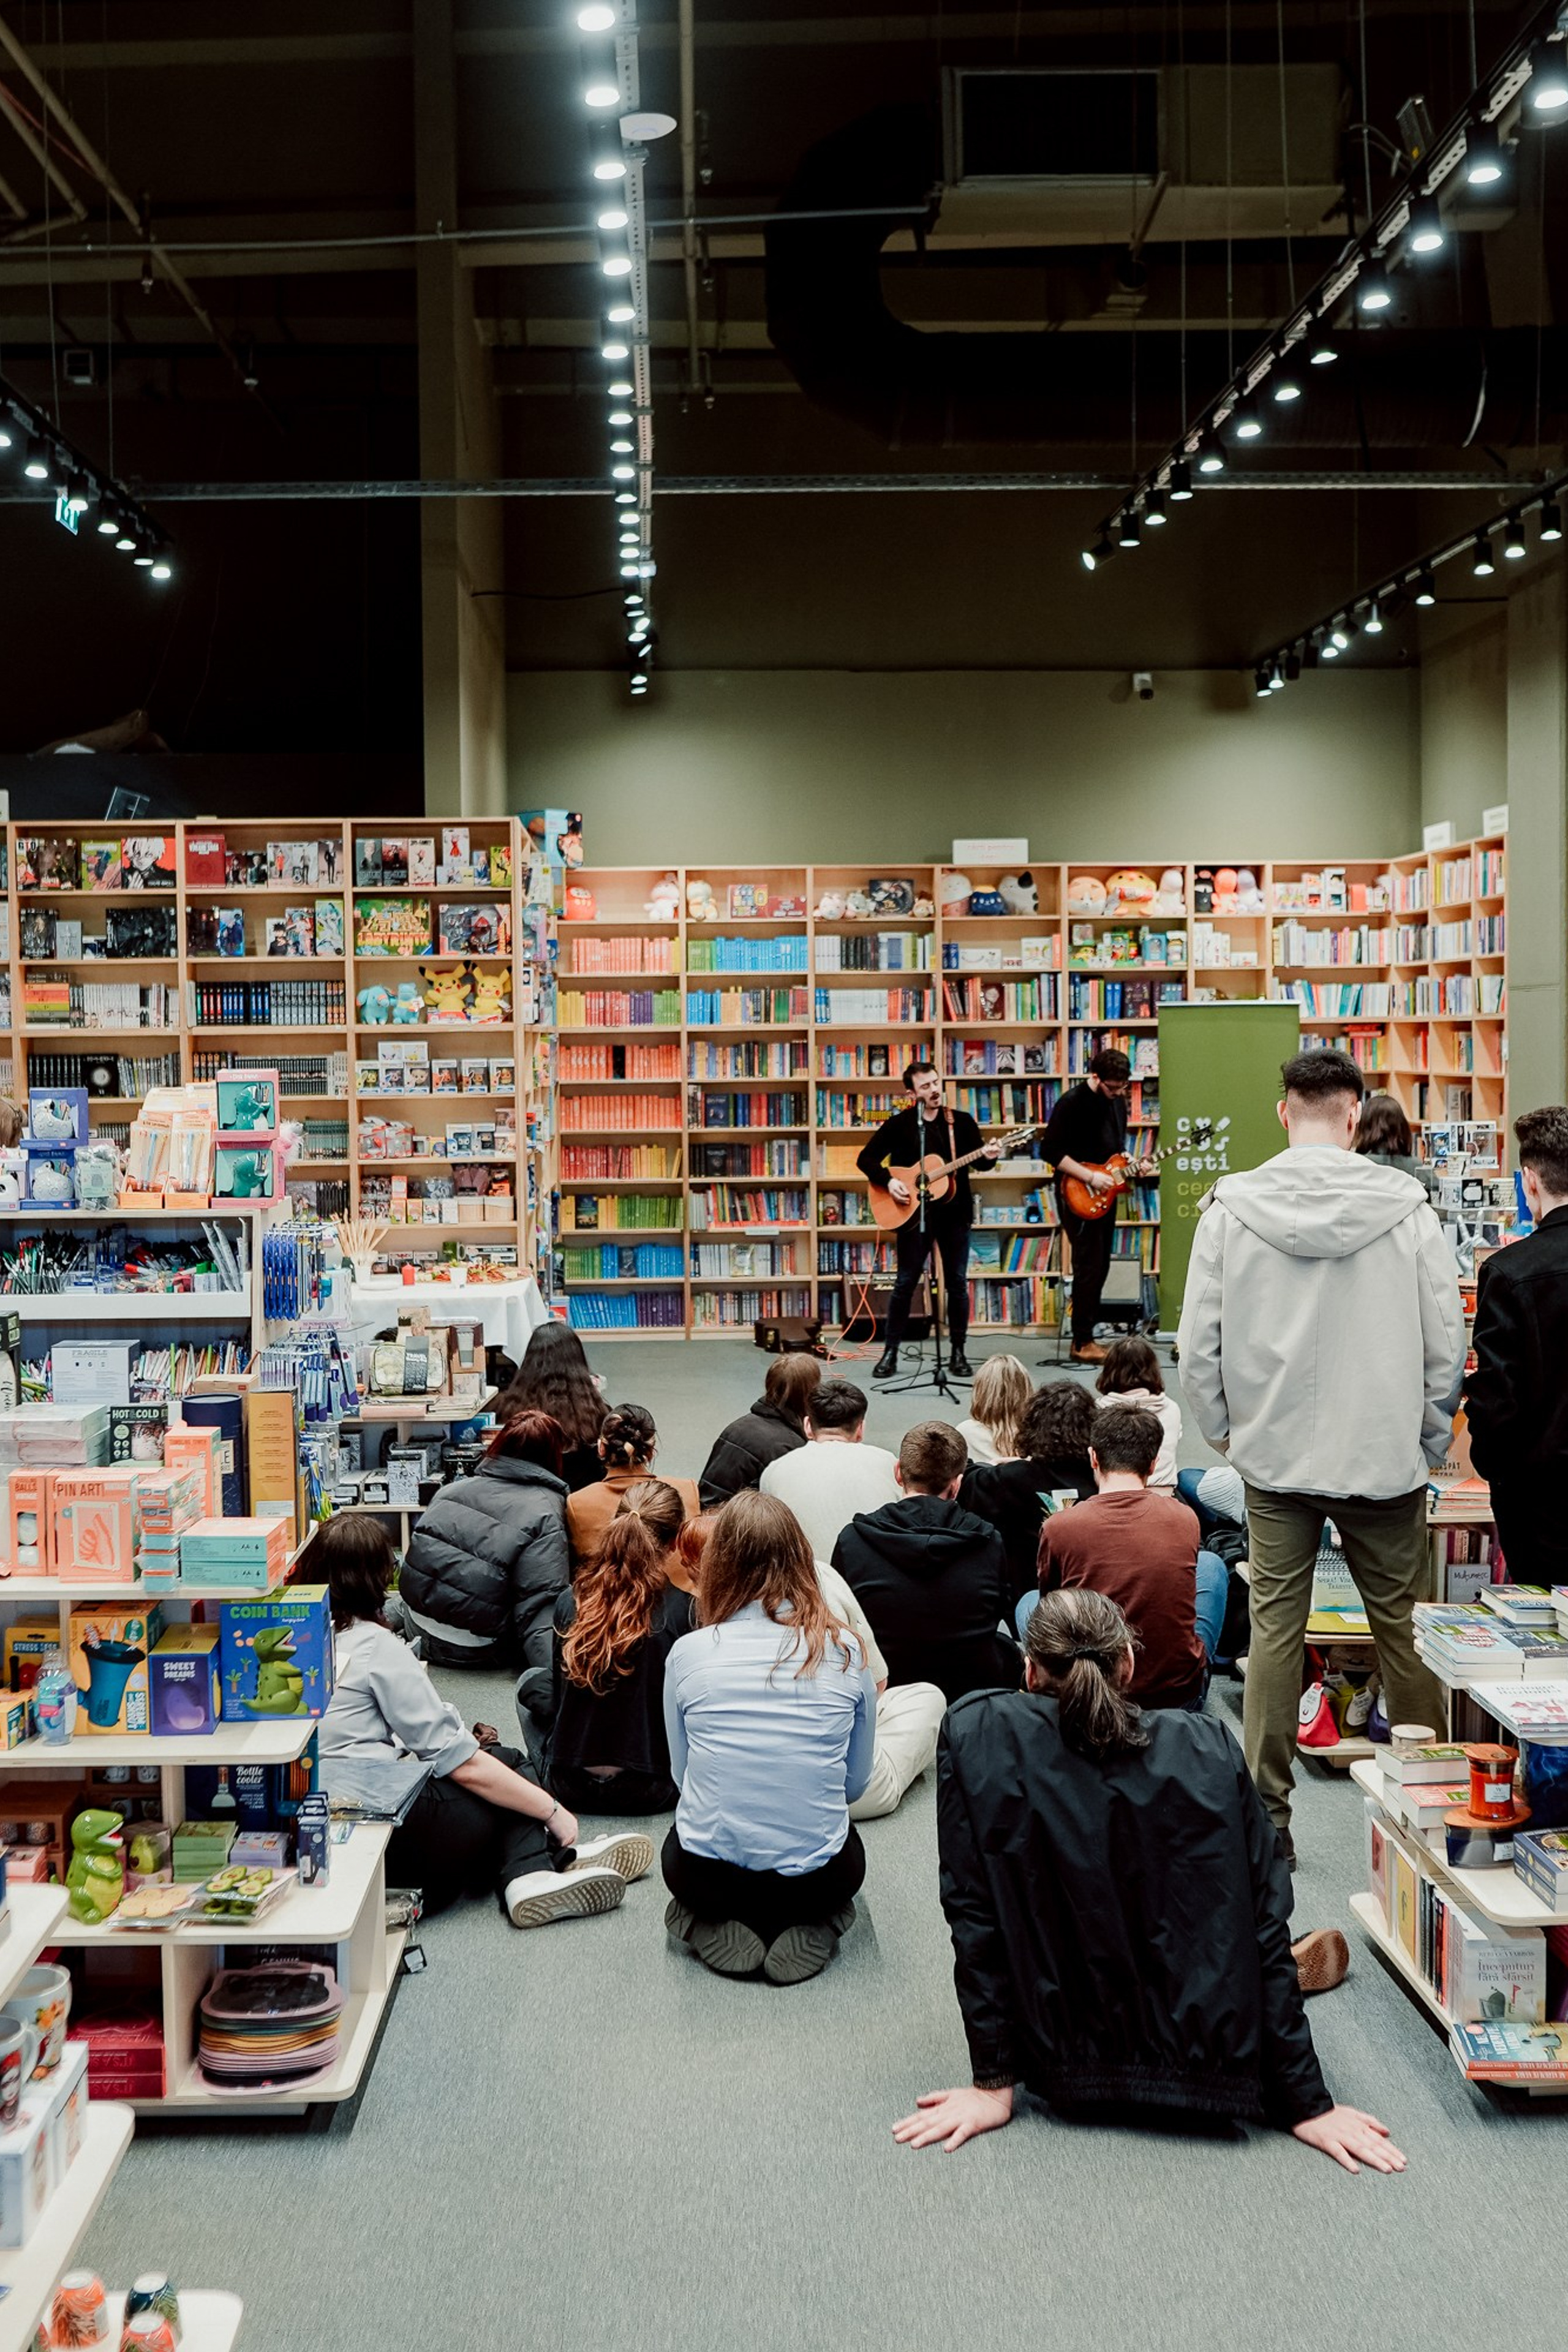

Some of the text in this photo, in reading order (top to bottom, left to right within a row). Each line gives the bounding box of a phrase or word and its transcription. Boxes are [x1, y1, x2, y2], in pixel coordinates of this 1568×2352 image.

[1176, 1153, 1230, 1175] ești
[112, 1410, 130, 1419] HOT
[135, 1409, 159, 1418] COLD
[58, 1483, 77, 1496] PIN
[80, 1482, 101, 1496] ART
[230, 1605, 311, 1619] COIN BANK
[13, 1642, 38, 1652] STRESS
[164, 1661, 195, 1671] SWEET
[164, 1670, 195, 1679] DREAMS
[236, 1766, 264, 1776] Bottle
[236, 1774, 264, 1784] cooler
